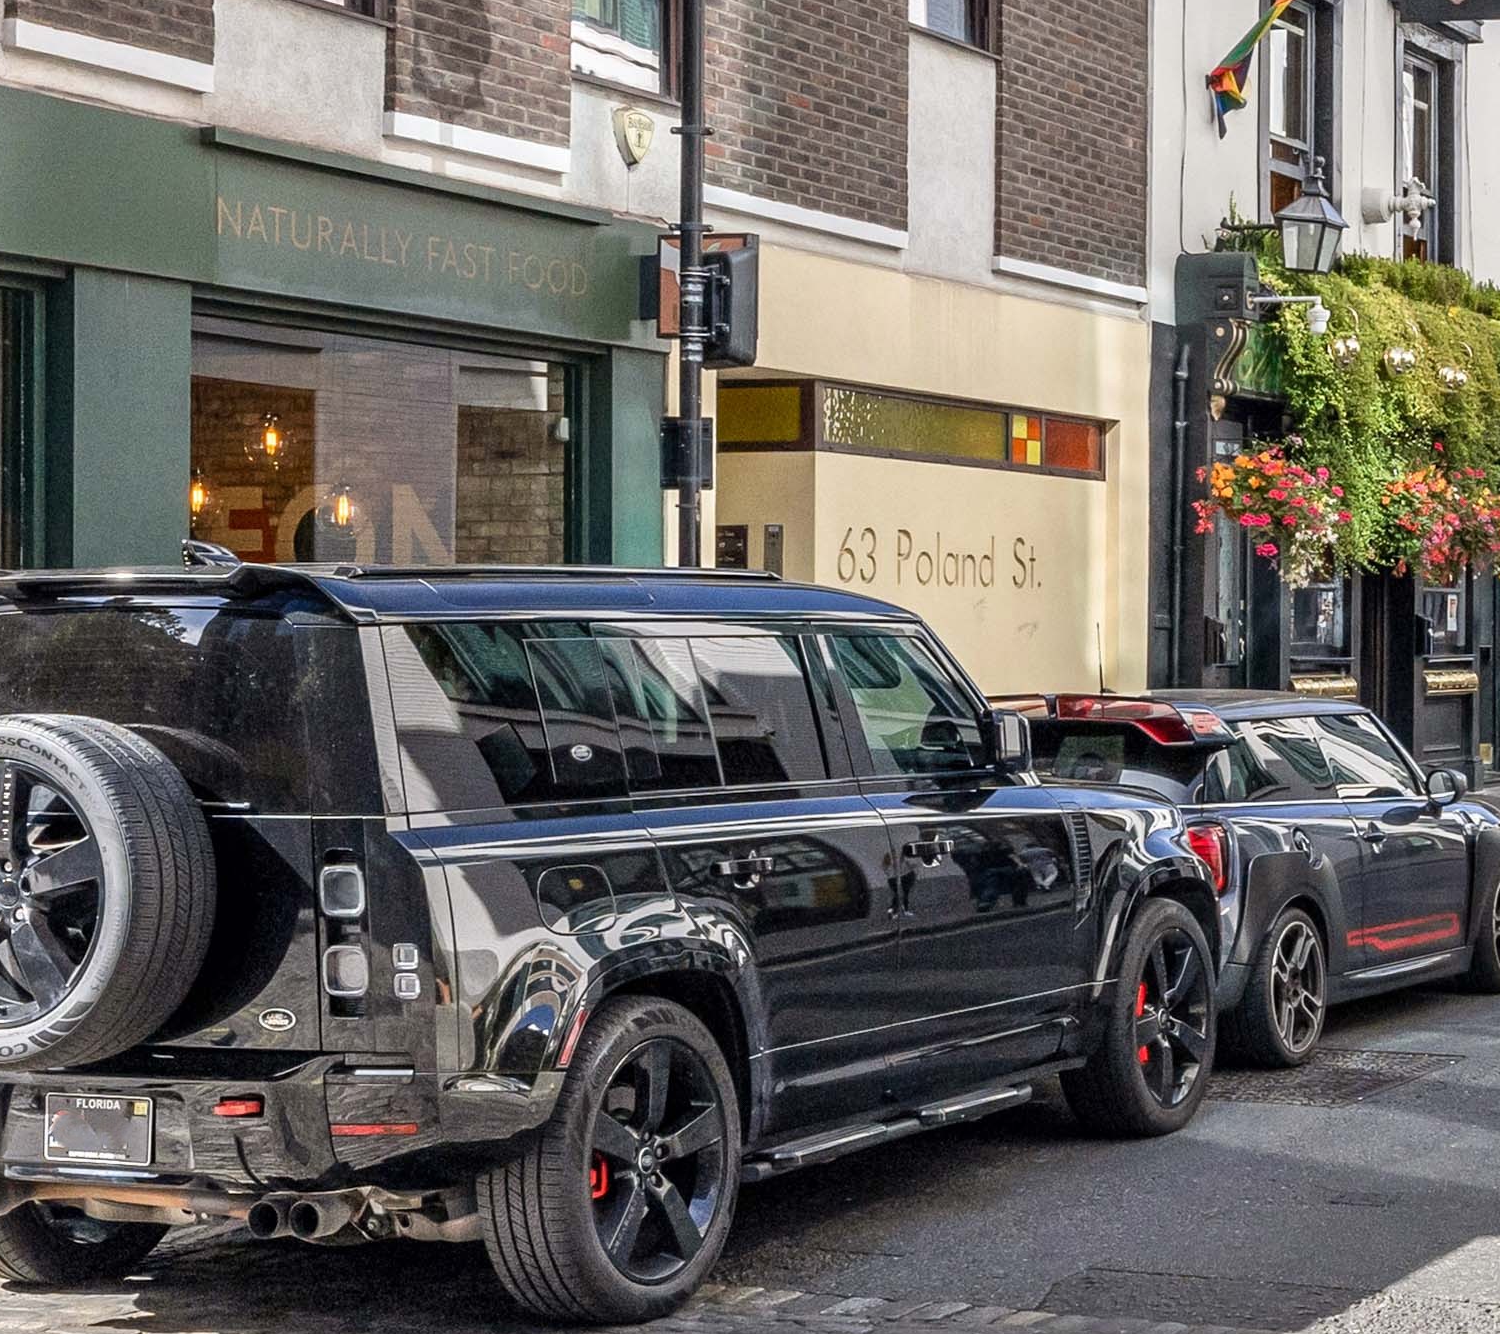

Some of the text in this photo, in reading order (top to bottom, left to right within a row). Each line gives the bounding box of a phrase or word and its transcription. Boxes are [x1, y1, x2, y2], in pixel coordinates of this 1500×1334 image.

[215, 196, 589, 297] NATURALLY FAST FOOD
[836, 526, 1042, 589] 63 Poland St.
[76, 1098, 121, 1110] FLORIDA
